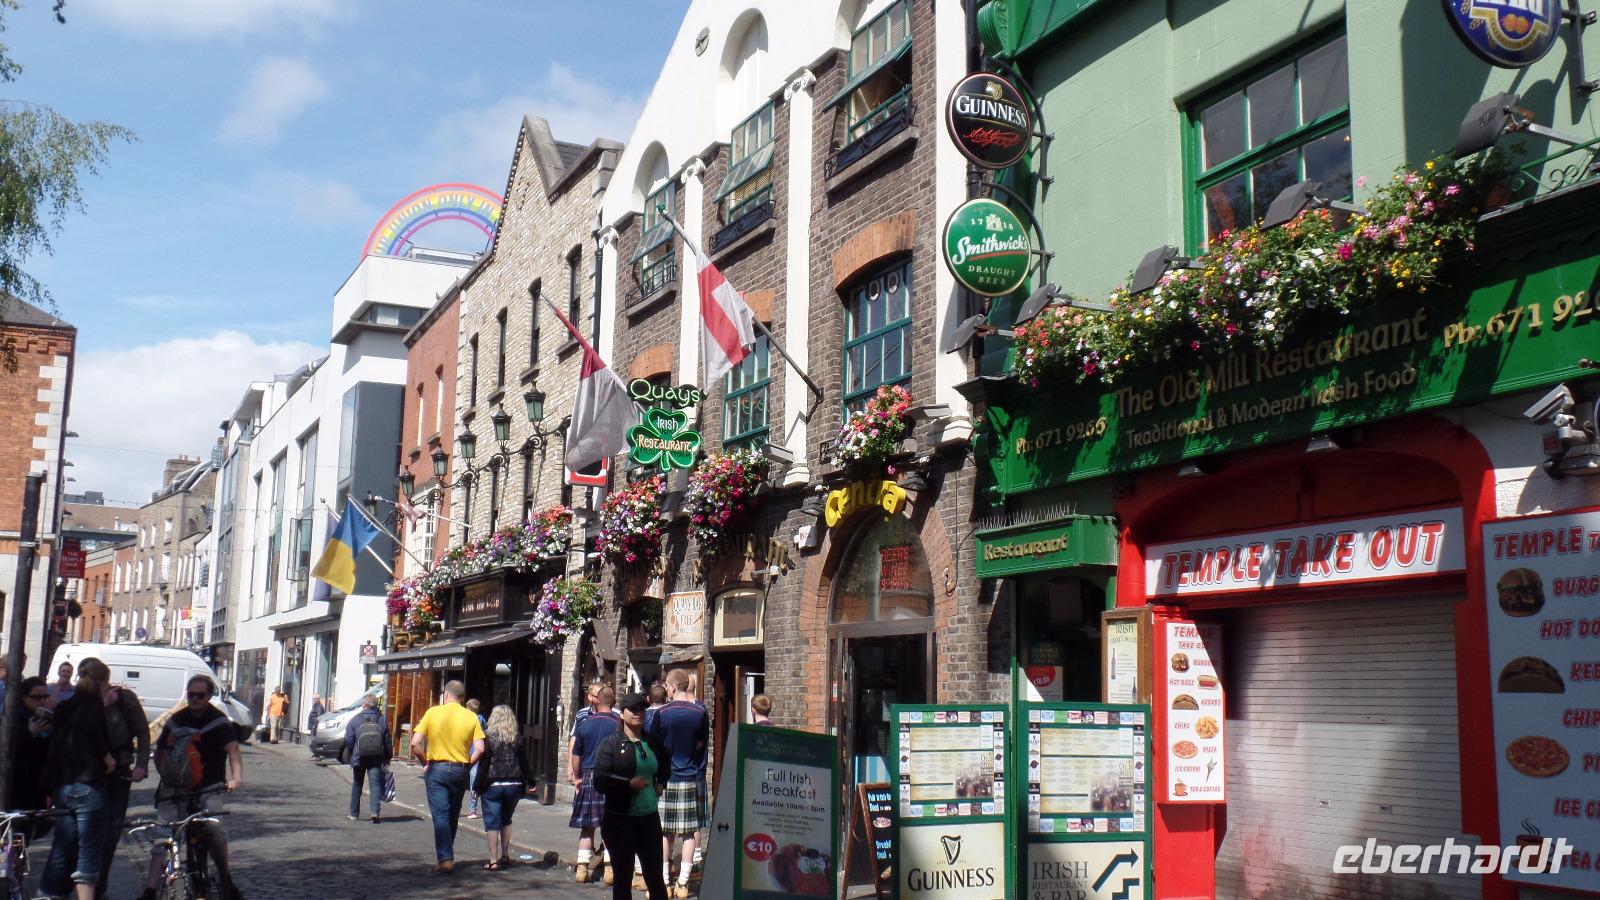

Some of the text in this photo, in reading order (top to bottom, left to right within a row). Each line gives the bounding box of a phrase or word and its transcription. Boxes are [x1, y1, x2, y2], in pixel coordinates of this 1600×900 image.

[955, 95, 1027, 128] GUINNESS
[952, 233, 1028, 265] Smithwick's
[968, 265, 1016, 277] DRAUGHT
[978, 276, 1006, 286] BEER
[1486, 302, 1544, 337] 671
[1116, 307, 1429, 419] The Old Mill Restaurant
[630, 378, 701, 407] Quays
[1126, 361, 1417, 449] Traditional & Modern Irish Food
[656, 416, 679, 431] Irish
[1036, 428, 1063, 449] 671
[1067, 416, 1107, 443] 9266
[636, 434, 692, 452] Restaurant
[824, 480, 907, 528] Centra
[983, 533, 1069, 561] Restaurant
[1493, 526, 1583, 560] TEMPLE
[1163, 521, 1446, 588] TEMPLE TAKE OUT
[1552, 575, 1600, 597] BURG
[1540, 617, 1600, 640] HOT DO
[1178, 641, 1195, 649] TAKE
[1562, 707, 1600, 728] CHIP
[767, 768, 811, 786] Full Irish
[761, 782, 817, 800] Breakfast
[751, 798, 784, 808] Available
[786, 803, 805, 811] 10am
[1553, 797, 1582, 818] ICE
[746, 841, 773, 854] €10
[907, 867, 995, 892] GUINNESS
[1032, 861, 1088, 880] IRISH
[1032, 880, 1089, 890] RESTAURANT
